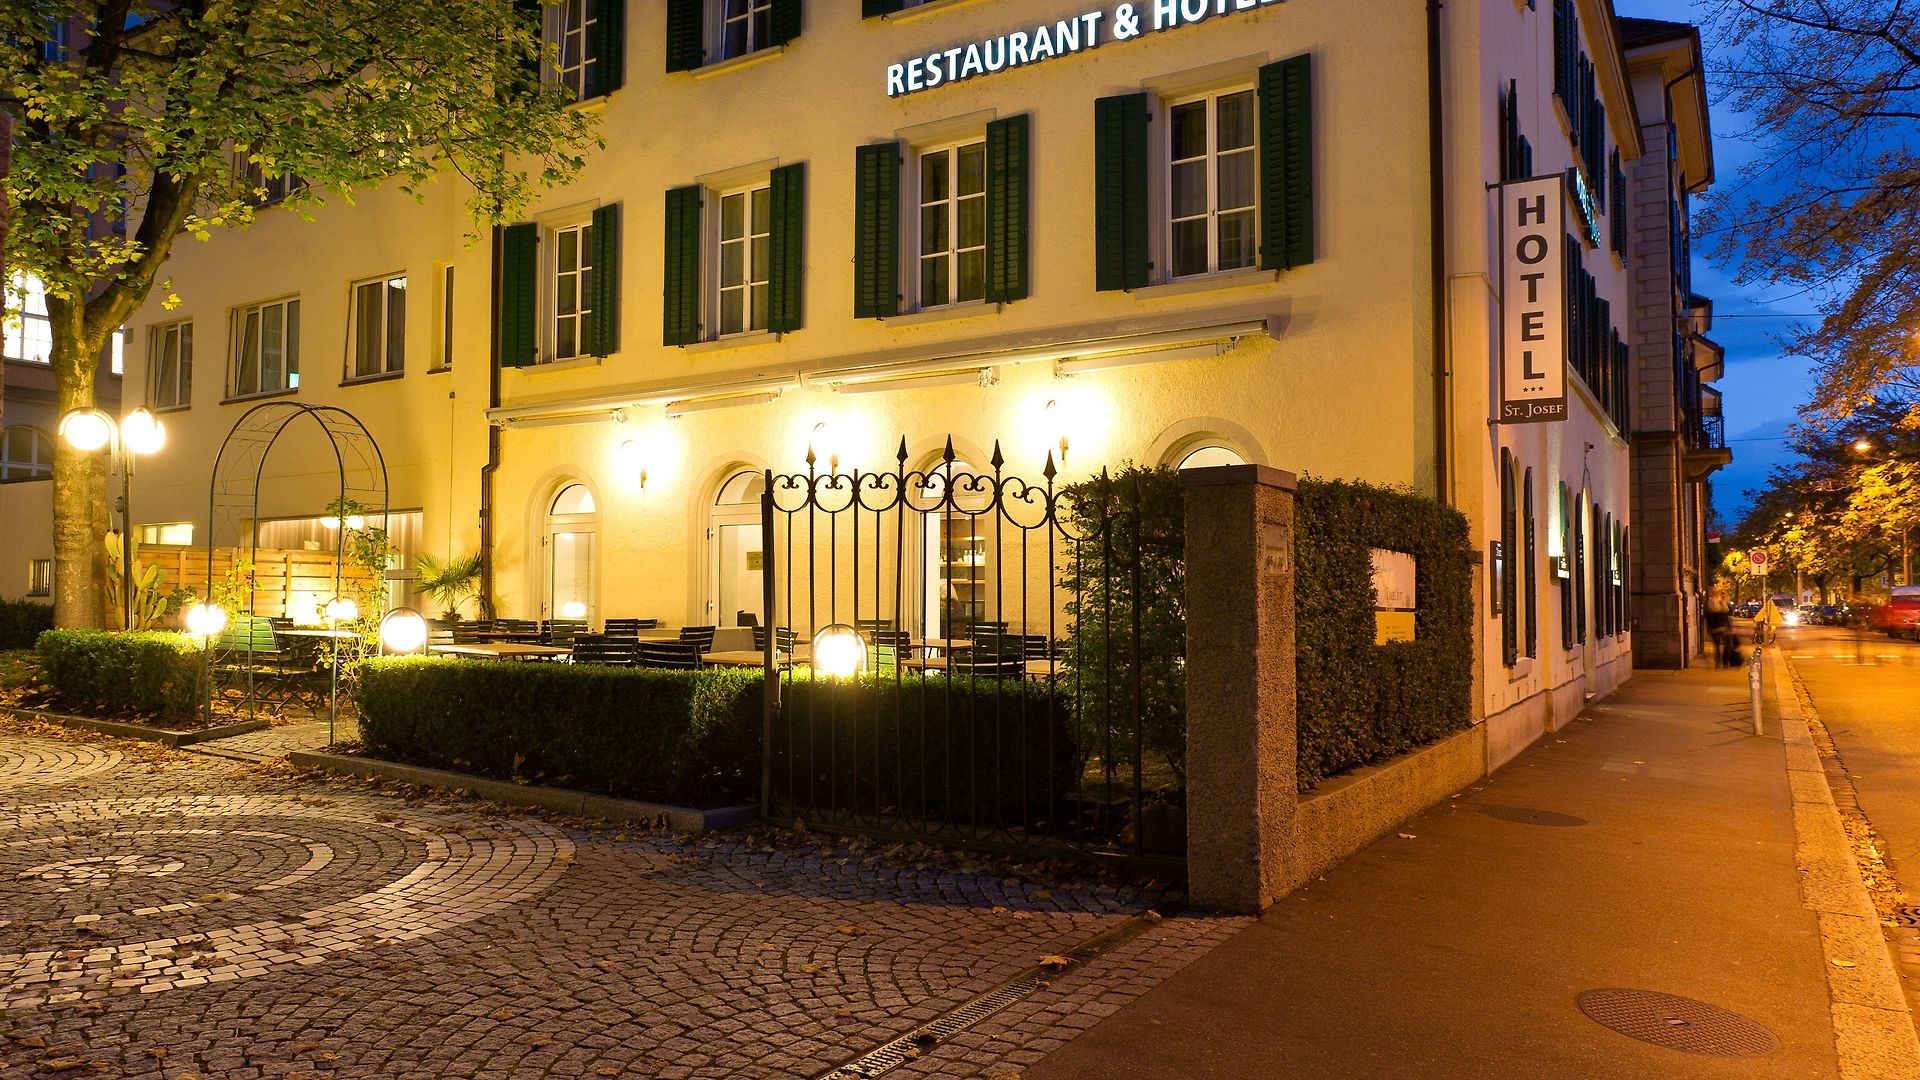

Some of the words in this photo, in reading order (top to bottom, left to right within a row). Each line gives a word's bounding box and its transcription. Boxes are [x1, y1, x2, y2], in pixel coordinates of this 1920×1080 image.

[887, 11, 1102, 96] RESTAURANT
[1112, 2, 1140, 40] &
[1515, 194, 1549, 381] HOTEL
